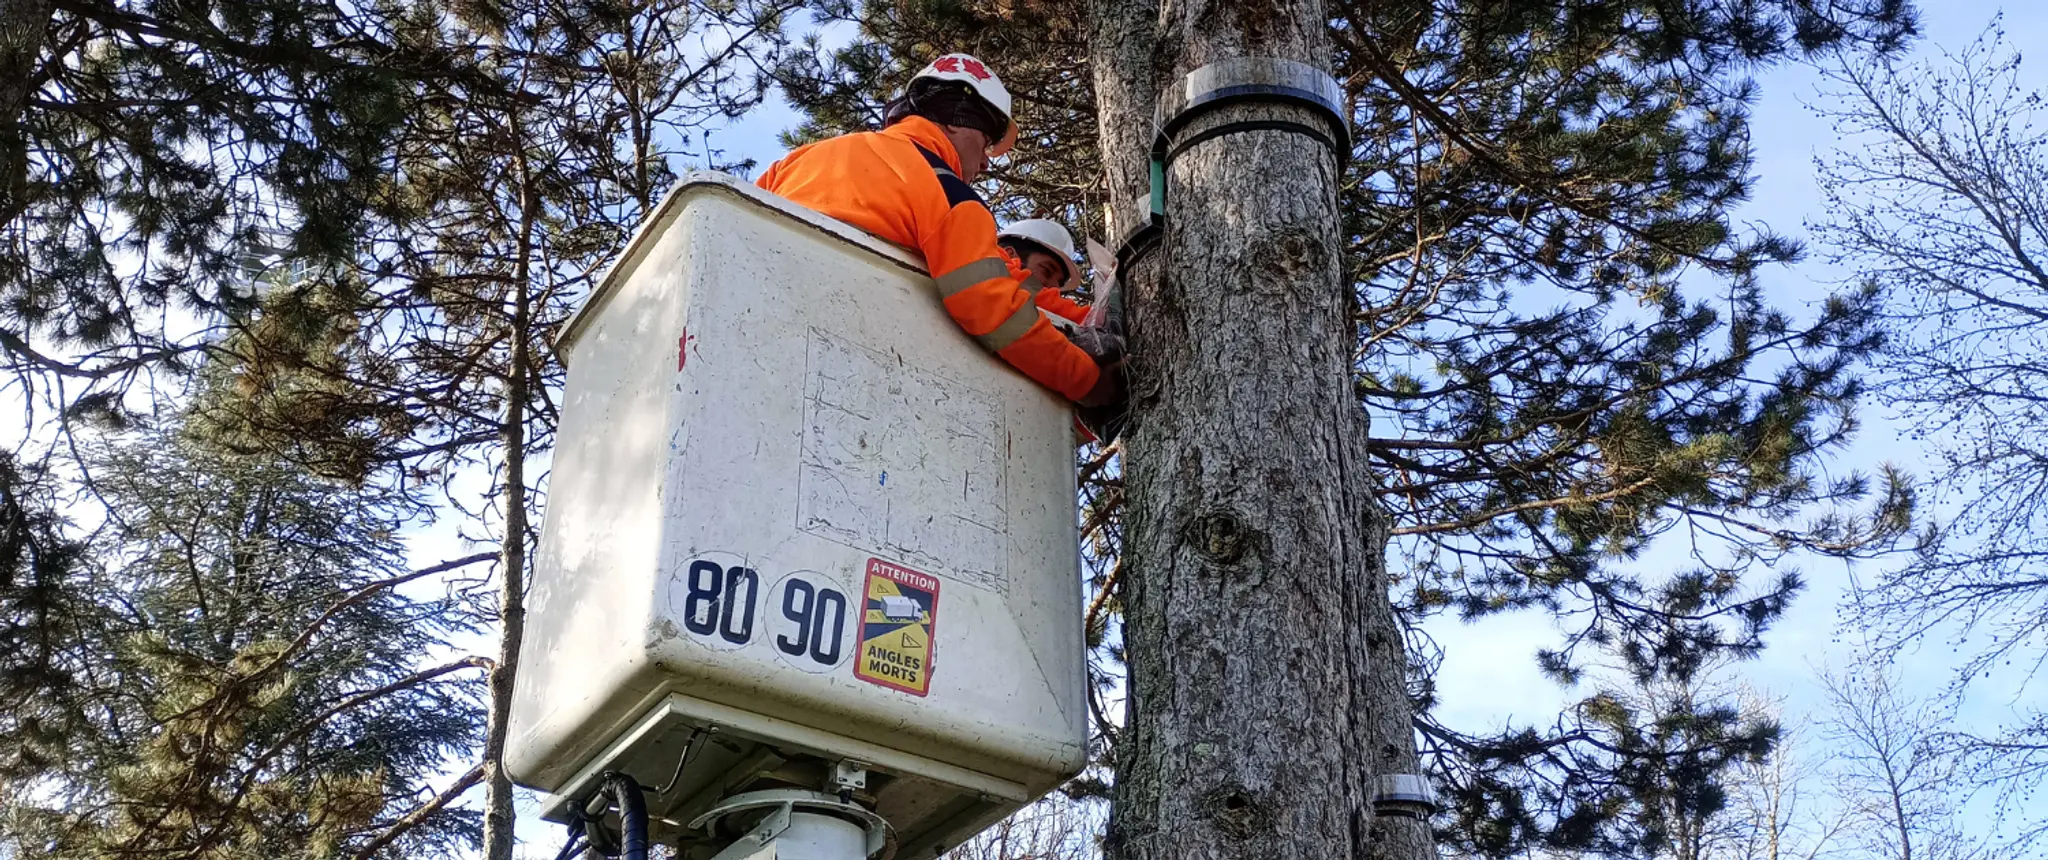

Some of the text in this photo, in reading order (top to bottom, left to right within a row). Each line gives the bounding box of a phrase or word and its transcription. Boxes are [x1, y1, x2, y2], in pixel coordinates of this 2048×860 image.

[871, 562, 936, 591] ATTENTION
[684, 559, 759, 646] 80
[776, 577, 847, 666] 90
[867, 645, 921, 670] ANGLES
[868, 659, 917, 683] MORTS
